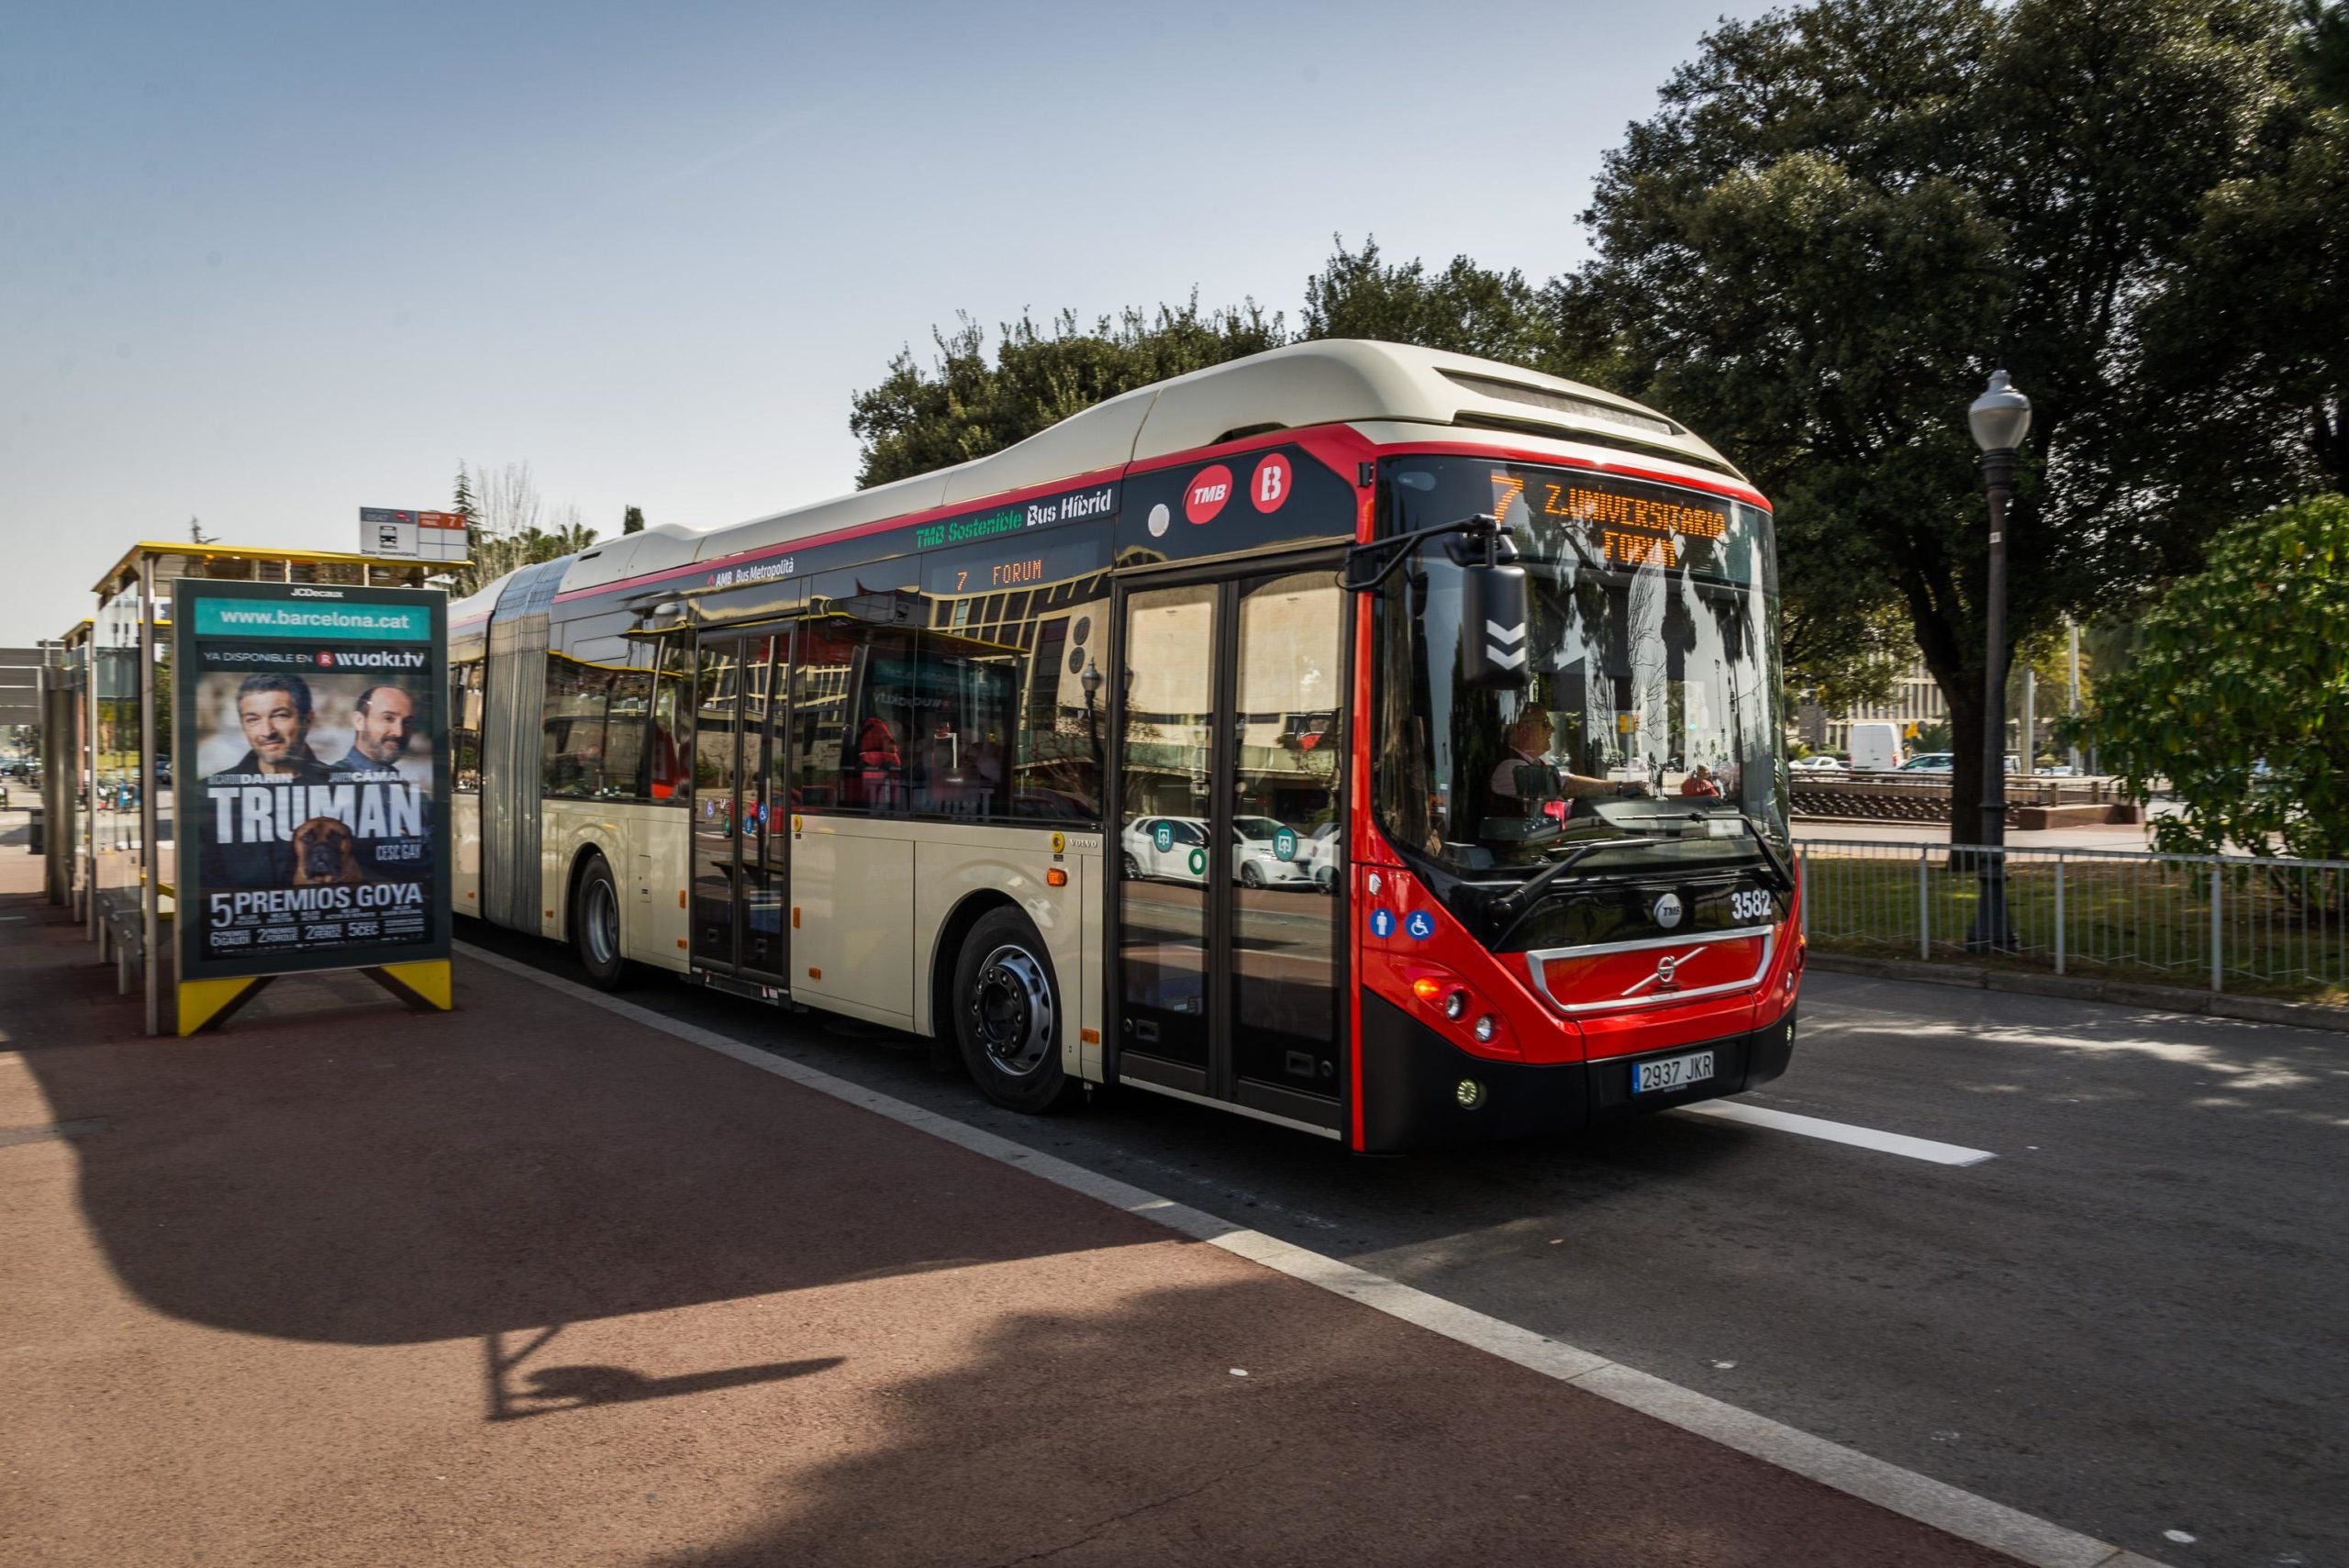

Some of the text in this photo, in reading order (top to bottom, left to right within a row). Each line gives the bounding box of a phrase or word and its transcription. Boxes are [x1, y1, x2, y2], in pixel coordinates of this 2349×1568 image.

[1194, 484, 1227, 505] TMB
[1261, 466, 1282, 502] B
[1490, 475, 1523, 525] 7
[916, 488, 1112, 549] TMB Sostenible Bus Híbrid
[1604, 531, 1676, 567] FORUM
[716, 557, 794, 588] AMB Bus Metropolità
[957, 559, 1042, 592] 7 FORUM
[220, 609, 409, 629] www.barcelona.cat
[204, 652, 313, 662] YA DISPONIBLE EN
[334, 651, 425, 667] wuaki.tv
[207, 784, 421, 843] TRUMAN
[1069, 839, 1098, 848] VOLVO
[210, 893, 233, 928] 5
[234, 886, 351, 914] PREMIOS
[356, 883, 423, 907] GOYA
[1662, 906, 1681, 917] TMB
[1731, 889, 1772, 919] 3582
[1642, 1055, 1712, 1089] 2937 JKR
